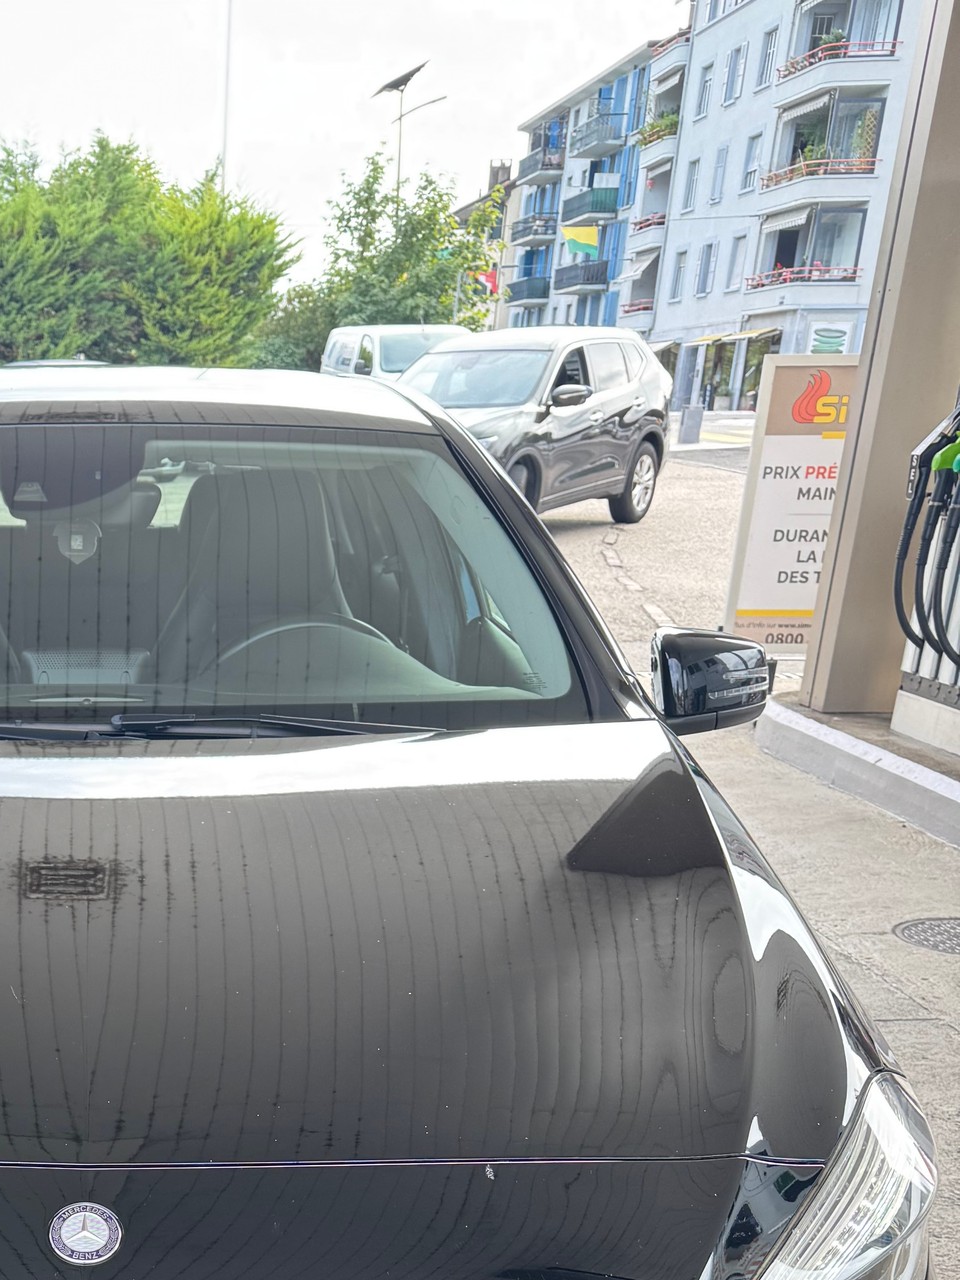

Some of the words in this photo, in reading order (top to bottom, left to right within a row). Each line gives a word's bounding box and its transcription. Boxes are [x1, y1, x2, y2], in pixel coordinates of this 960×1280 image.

[762, 465, 802, 480] PRIX
[804, 462, 838, 480] PRÉ
[796, 549, 817, 563] LA
[777, 570, 809, 584] DES
[765, 632, 804, 644] 0800
[61, 1205, 109, 1220] MERCEDES
[72, 1251, 99, 1260] BENZ
